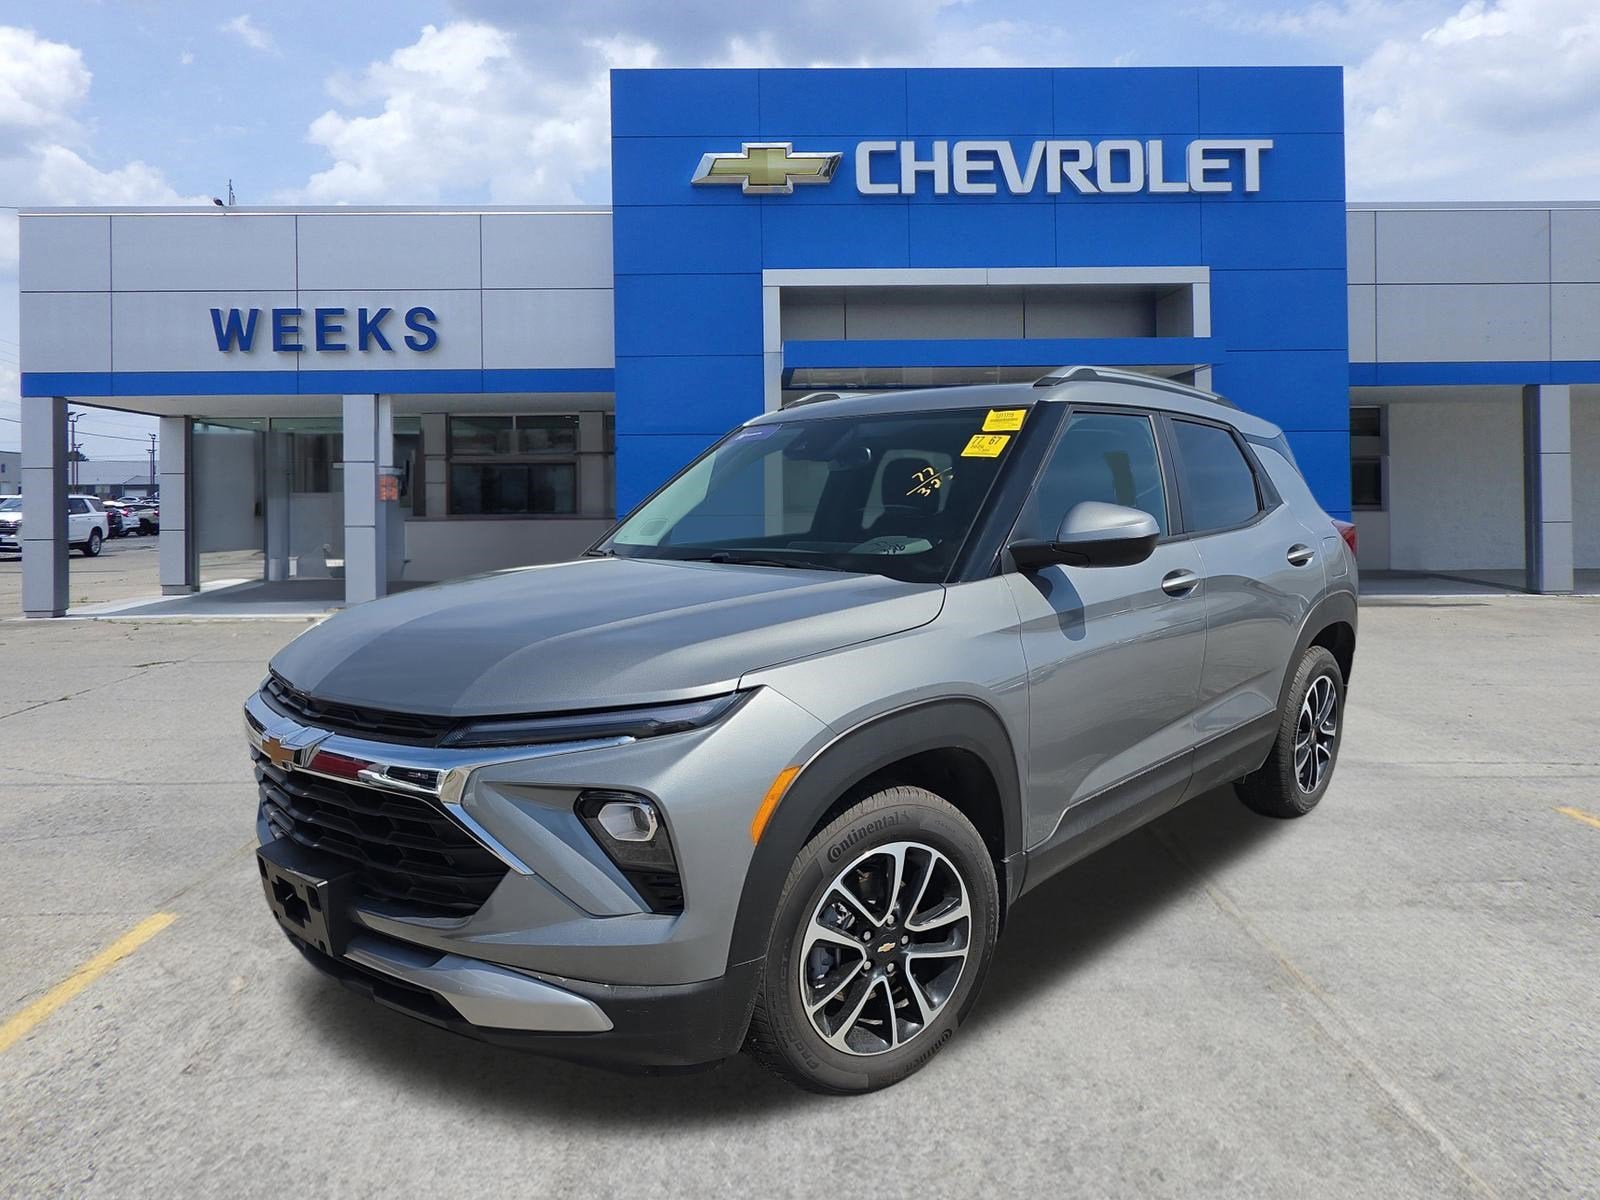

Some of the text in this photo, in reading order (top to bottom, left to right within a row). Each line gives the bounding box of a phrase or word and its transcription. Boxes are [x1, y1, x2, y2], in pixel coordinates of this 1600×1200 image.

[855, 139, 1274, 195] CHEVROLET
[209, 306, 439, 352] WEEKS
[827, 811, 900, 864] Continental
